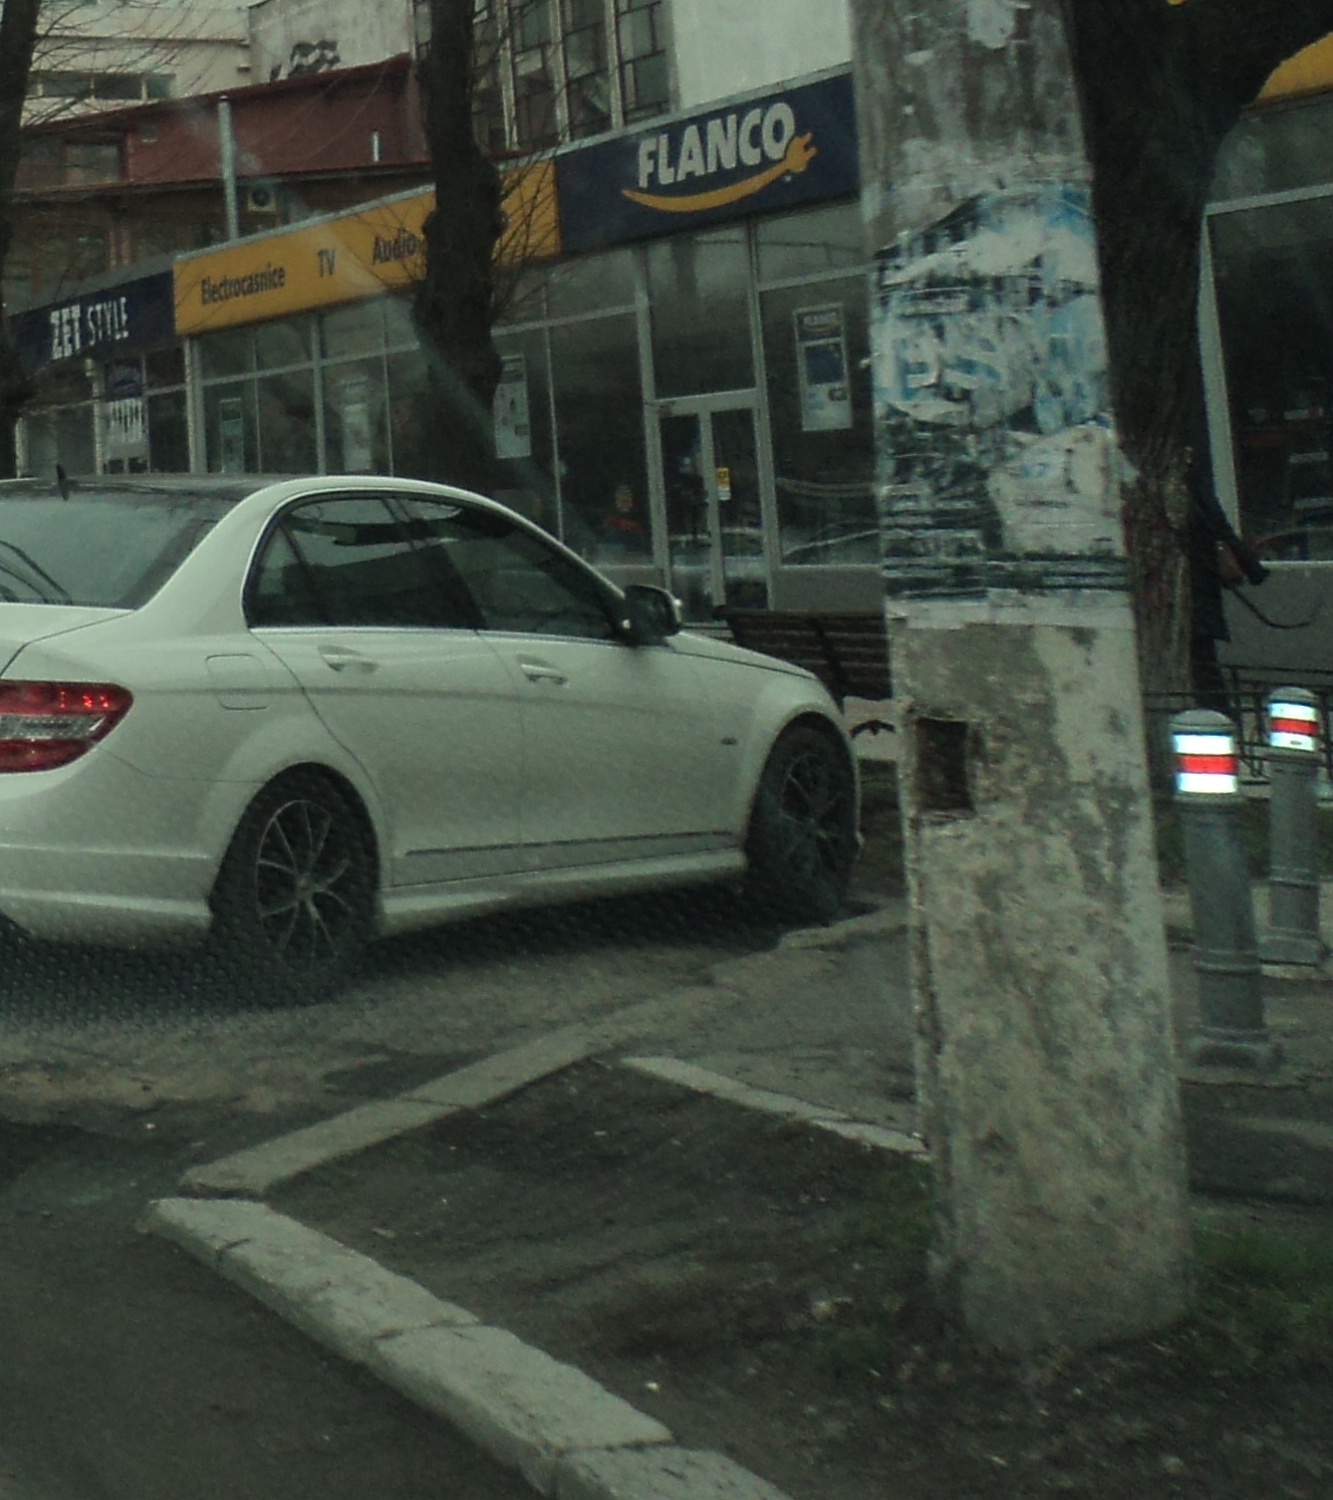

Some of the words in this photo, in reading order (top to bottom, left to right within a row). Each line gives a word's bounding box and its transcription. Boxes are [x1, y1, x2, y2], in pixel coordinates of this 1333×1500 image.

[638, 102, 796, 190] FLANCO
[200, 261, 287, 305] Electrocasnice
[317, 248, 337, 278] TV
[49, 304, 82, 361] ZET
[87, 296, 130, 346] STYLE
